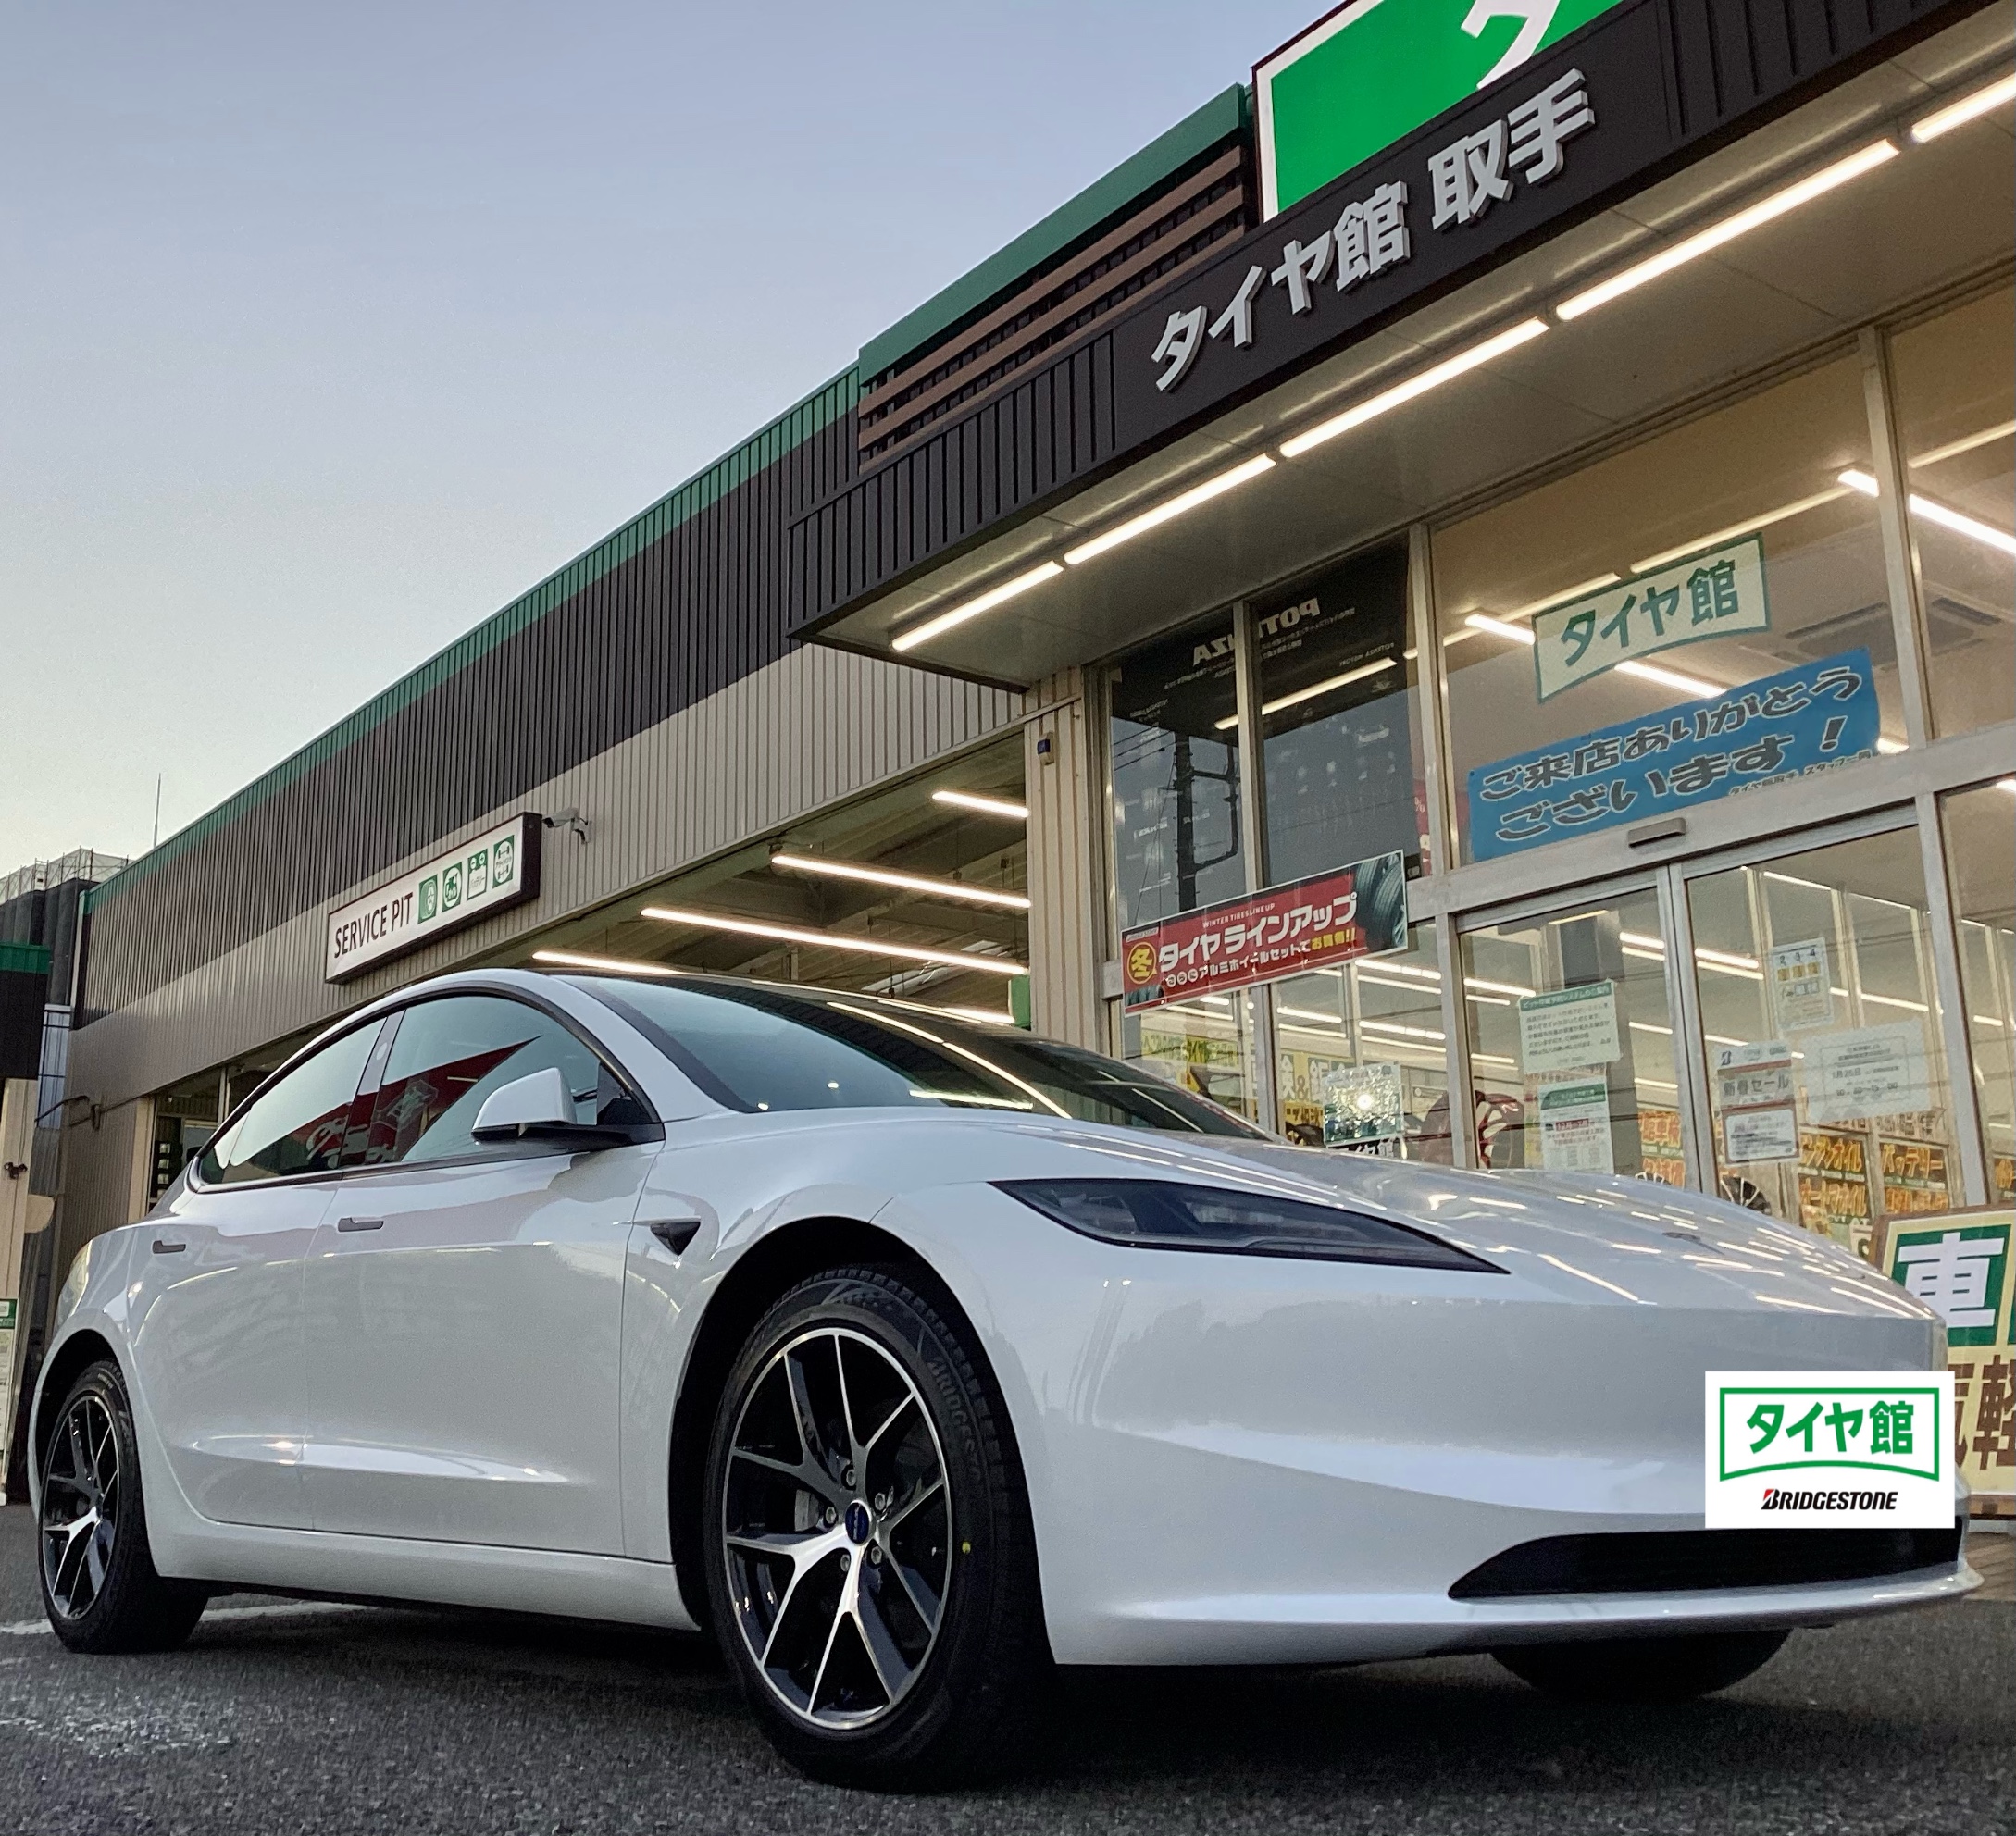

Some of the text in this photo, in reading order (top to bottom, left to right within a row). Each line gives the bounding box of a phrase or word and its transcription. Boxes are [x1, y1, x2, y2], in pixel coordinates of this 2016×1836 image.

[1151, 68, 1595, 391] タイヤ館 取手
[1561, 559, 1739, 666] タイヤ館
[1480, 665, 1863, 802] ご来店ありがとう
[334, 892, 413, 959] SERVICE PIT
[1202, 915, 1229, 928] WINTER
[1883, 1144, 1944, 1179] バッテリー
[1897, 1232, 2005, 1328] 車
